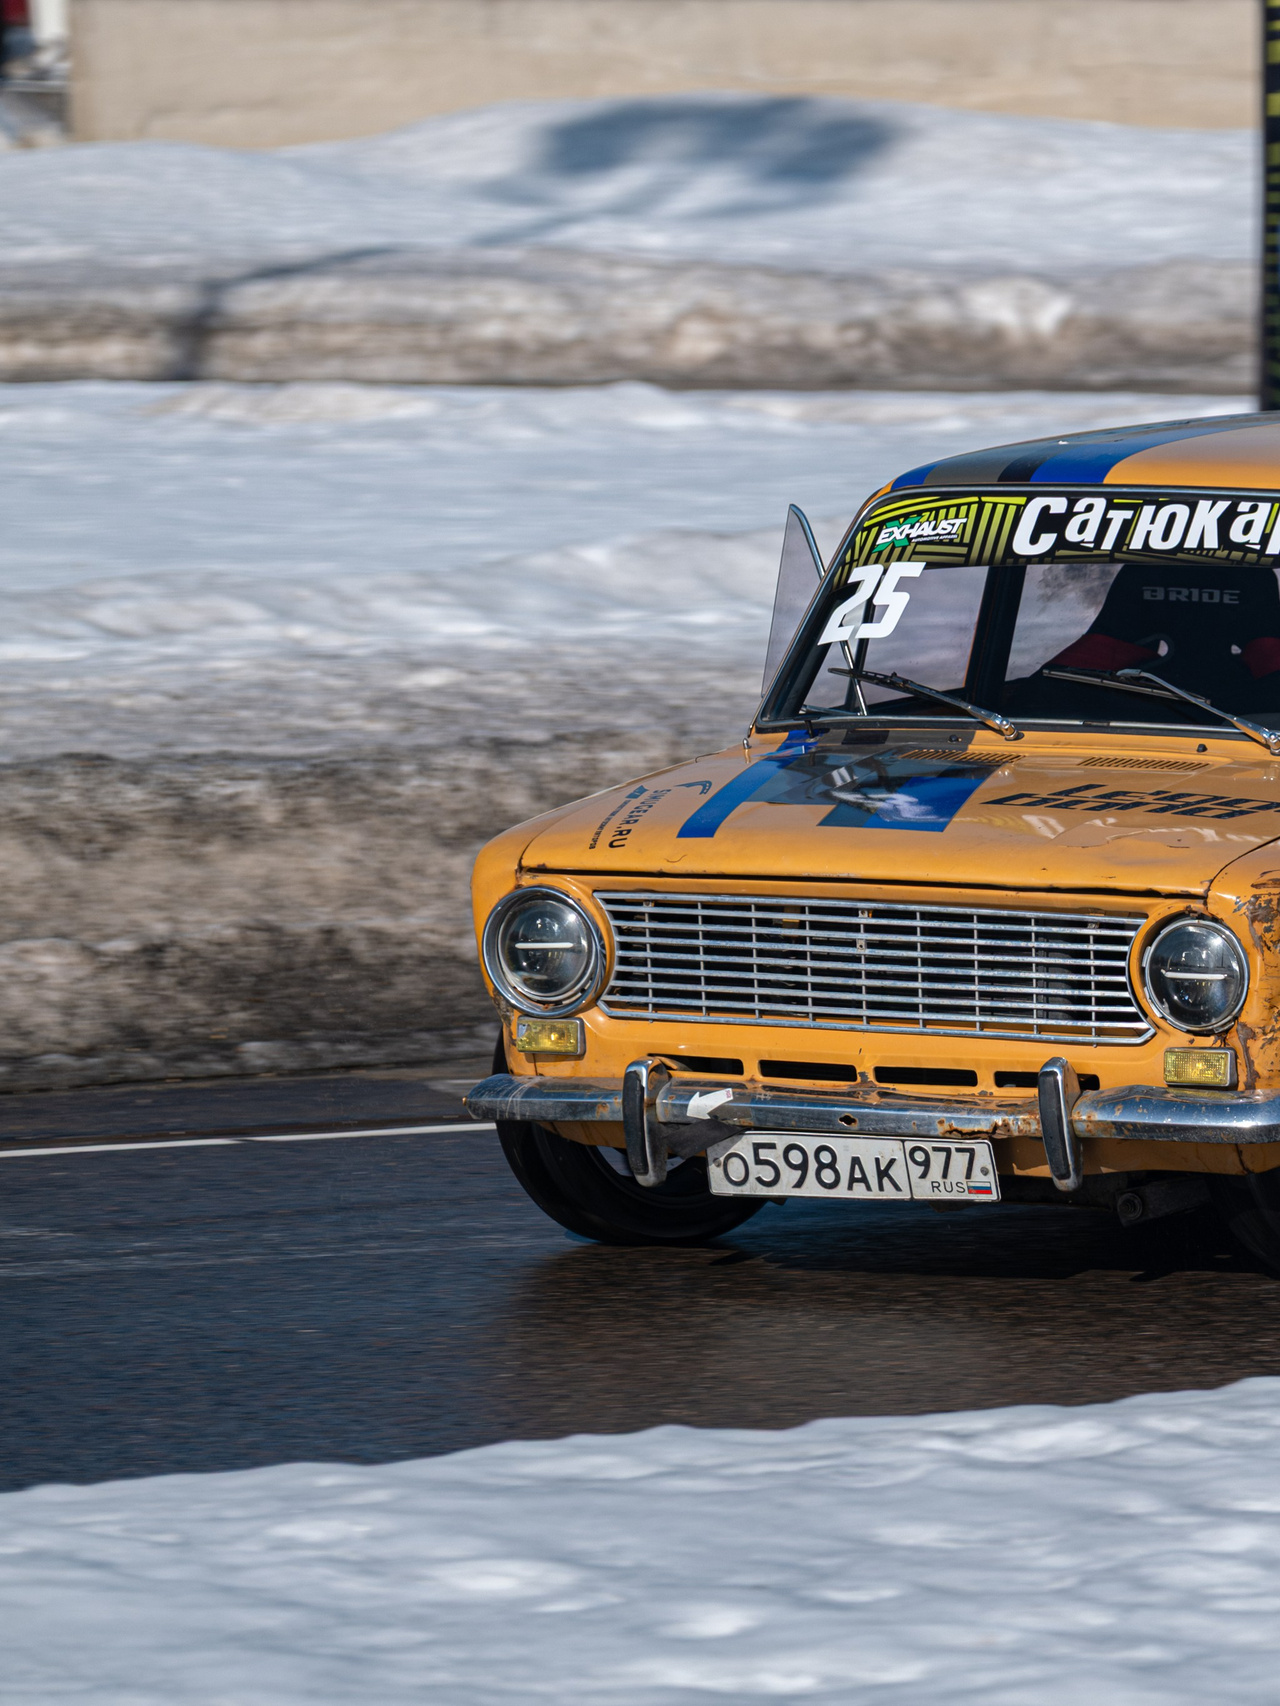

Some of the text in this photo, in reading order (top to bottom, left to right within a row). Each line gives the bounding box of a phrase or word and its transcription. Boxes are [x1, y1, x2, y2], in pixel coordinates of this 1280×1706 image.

[875, 517, 968, 546] EXHAUST
[817, 561, 927, 646] 25
[1142, 586, 1241, 605] BRIDE
[908, 1144, 976, 1180] 977
[930, 1180, 966, 1195] RUS
